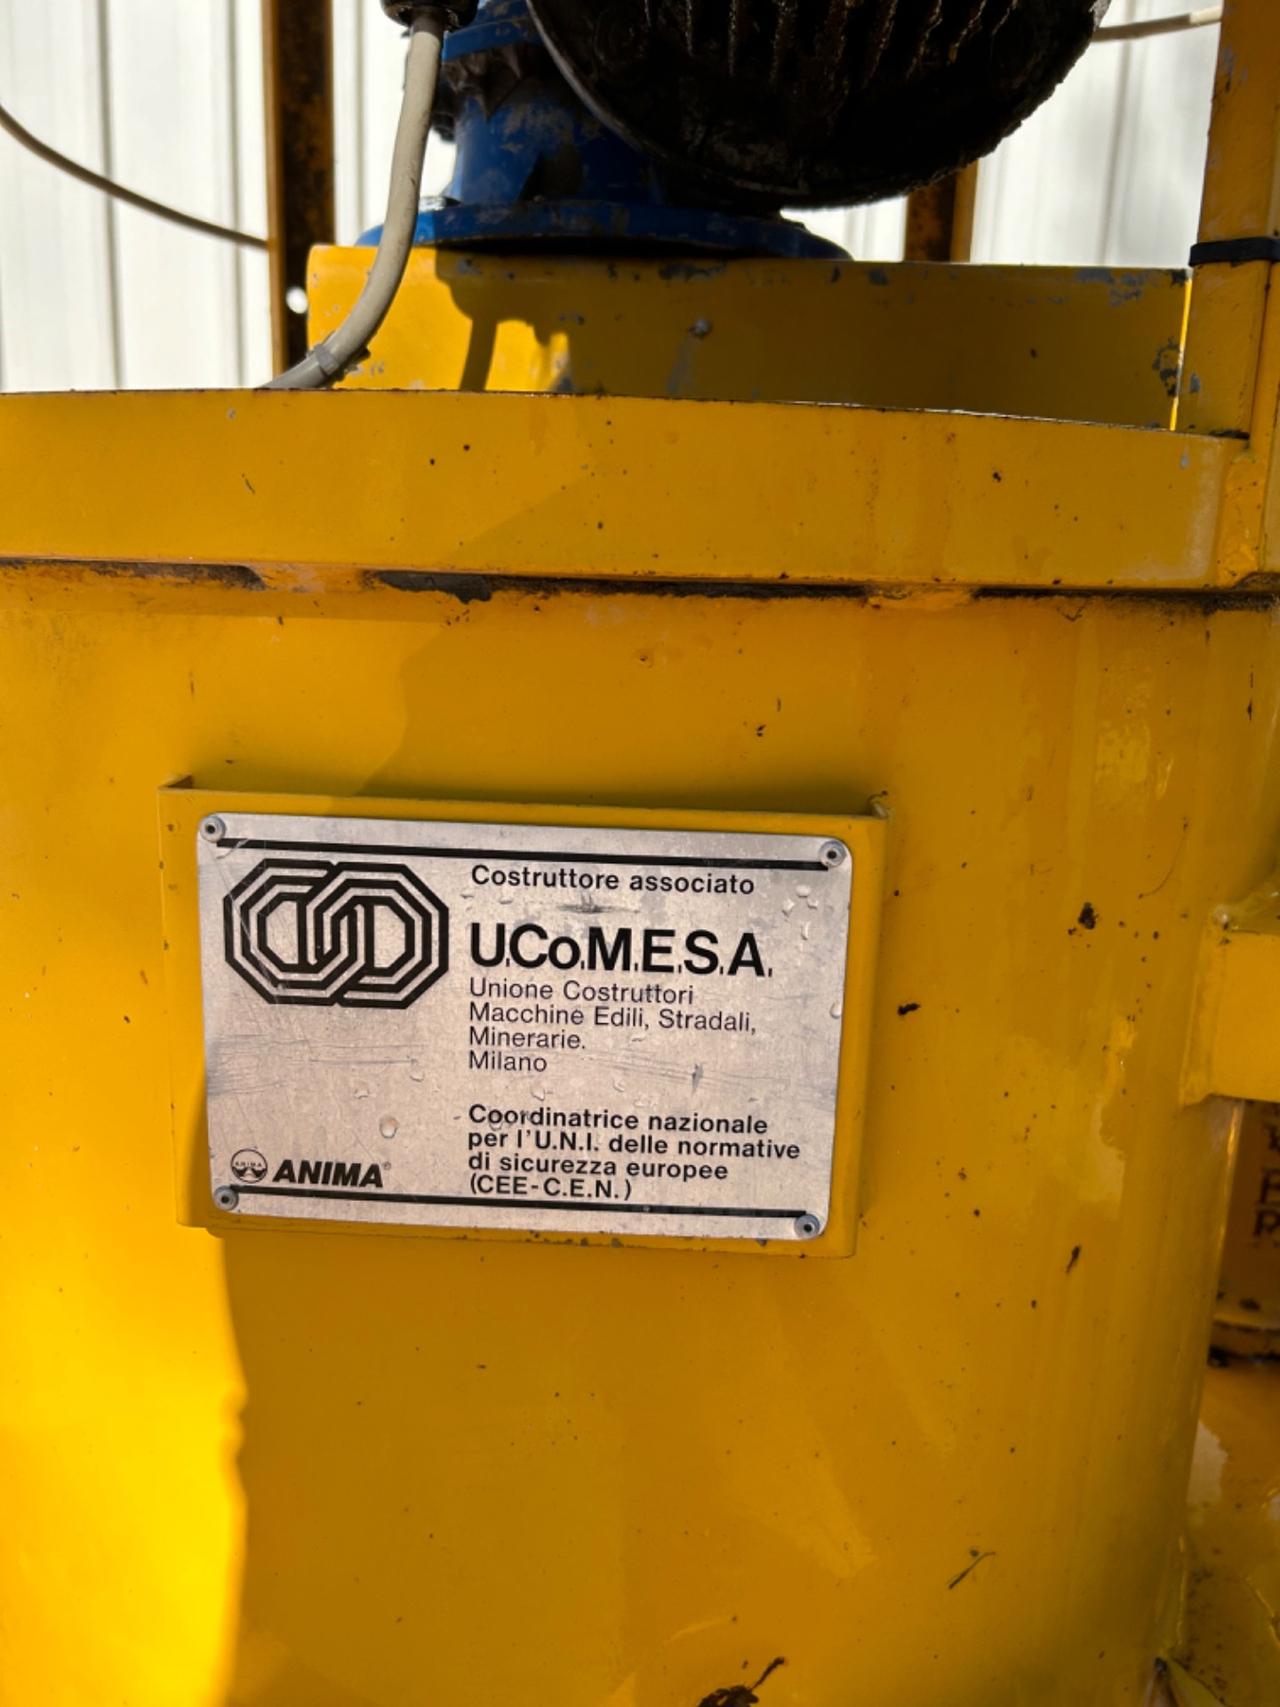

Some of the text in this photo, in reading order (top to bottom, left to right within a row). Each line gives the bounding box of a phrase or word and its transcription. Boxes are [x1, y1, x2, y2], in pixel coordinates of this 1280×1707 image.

[471, 864, 755, 895] Costruttore associato
[469, 921, 773, 978] U.Co.M.E.S.A.
[469, 976, 694, 1005] Unione Costruttori
[469, 1000, 756, 1036] Macchine Edili, Stradali,
[469, 1025, 586, 1050] Minerarie.
[468, 1049, 548, 1073] Milano
[468, 1103, 768, 1135] Coordinatrice nazionale
[468, 1132, 509, 1151] per
[608, 1133, 668, 1155] delle
[677, 1139, 801, 1160] normative
[272, 1159, 384, 1188] ANIMA
[468, 1151, 729, 1183] di sicurezza europee
